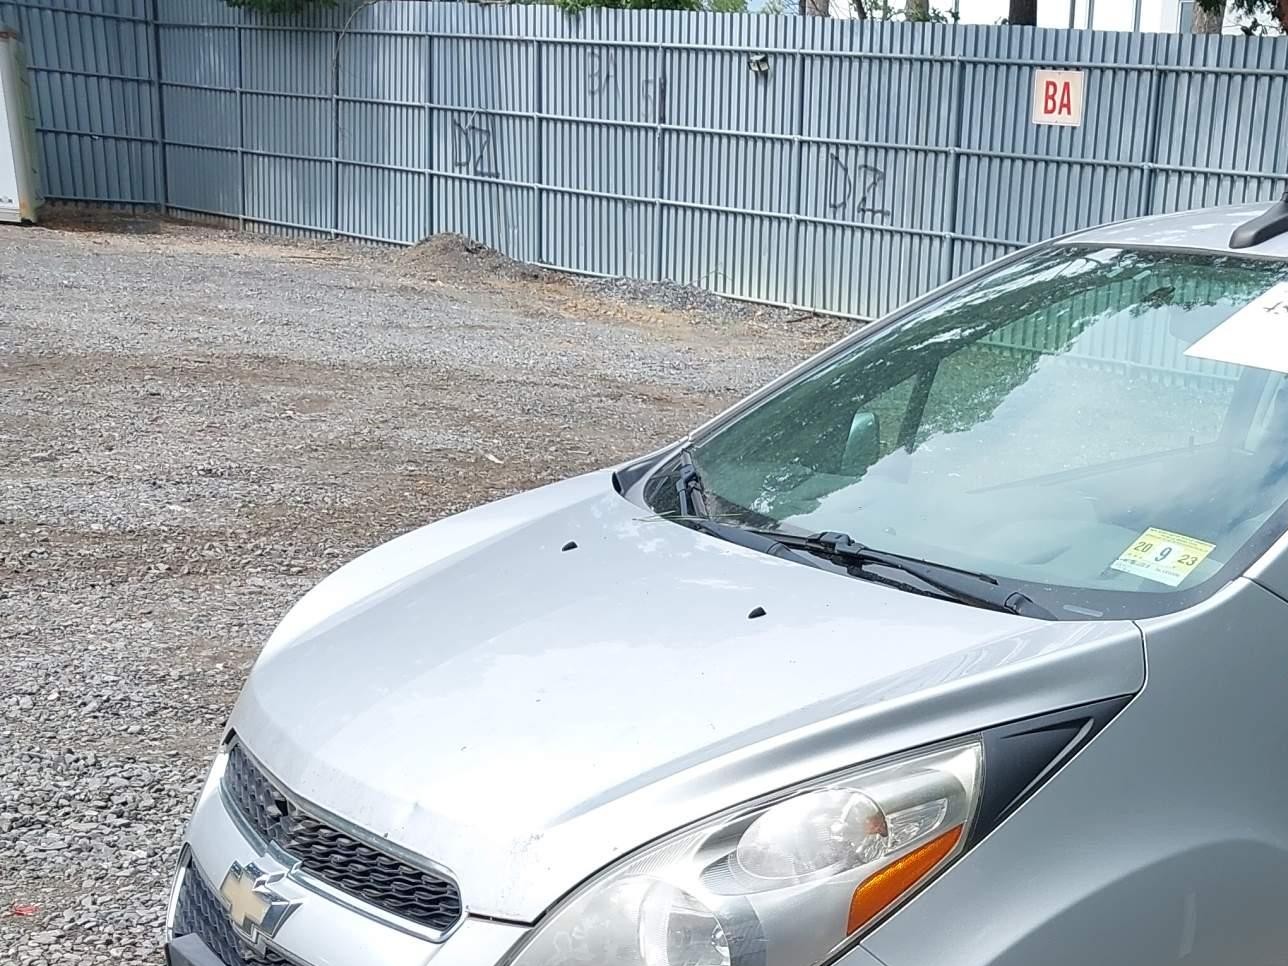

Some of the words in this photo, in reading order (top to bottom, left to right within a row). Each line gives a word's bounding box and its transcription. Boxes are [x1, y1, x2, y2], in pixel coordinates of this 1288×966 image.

[1043, 80, 1072, 116] BA
[1134, 541, 1154, 554] 20
[1155, 545, 1173, 562] 9
[1177, 553, 1199, 567] 23
